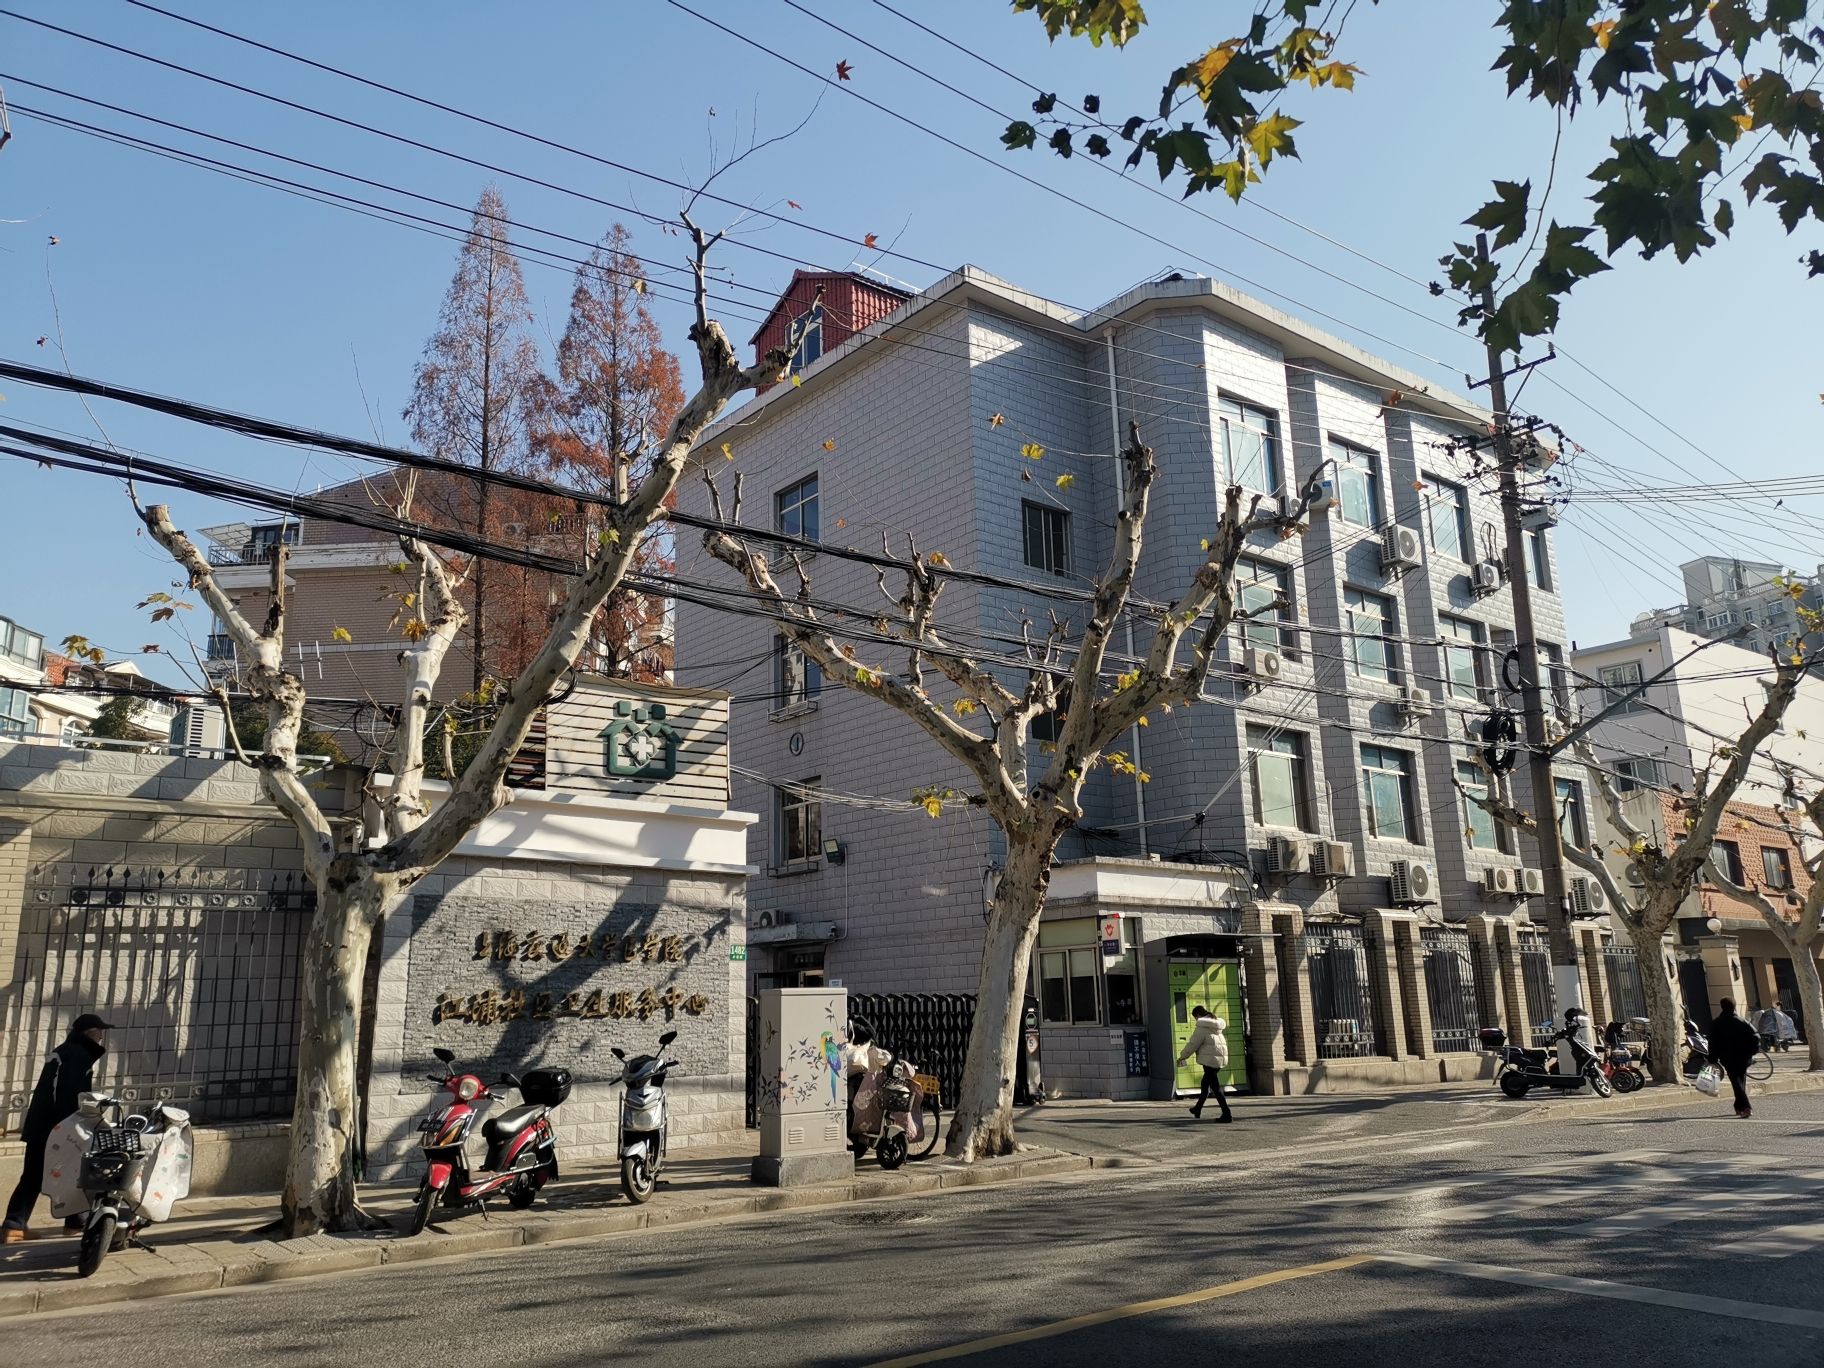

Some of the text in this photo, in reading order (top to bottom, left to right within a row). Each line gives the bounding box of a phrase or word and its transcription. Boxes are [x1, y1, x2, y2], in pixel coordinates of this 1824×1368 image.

[477, 929, 684, 962] 上海交通大学医学院
[438, 986, 709, 1026] 江浦社区卫生服务中心
